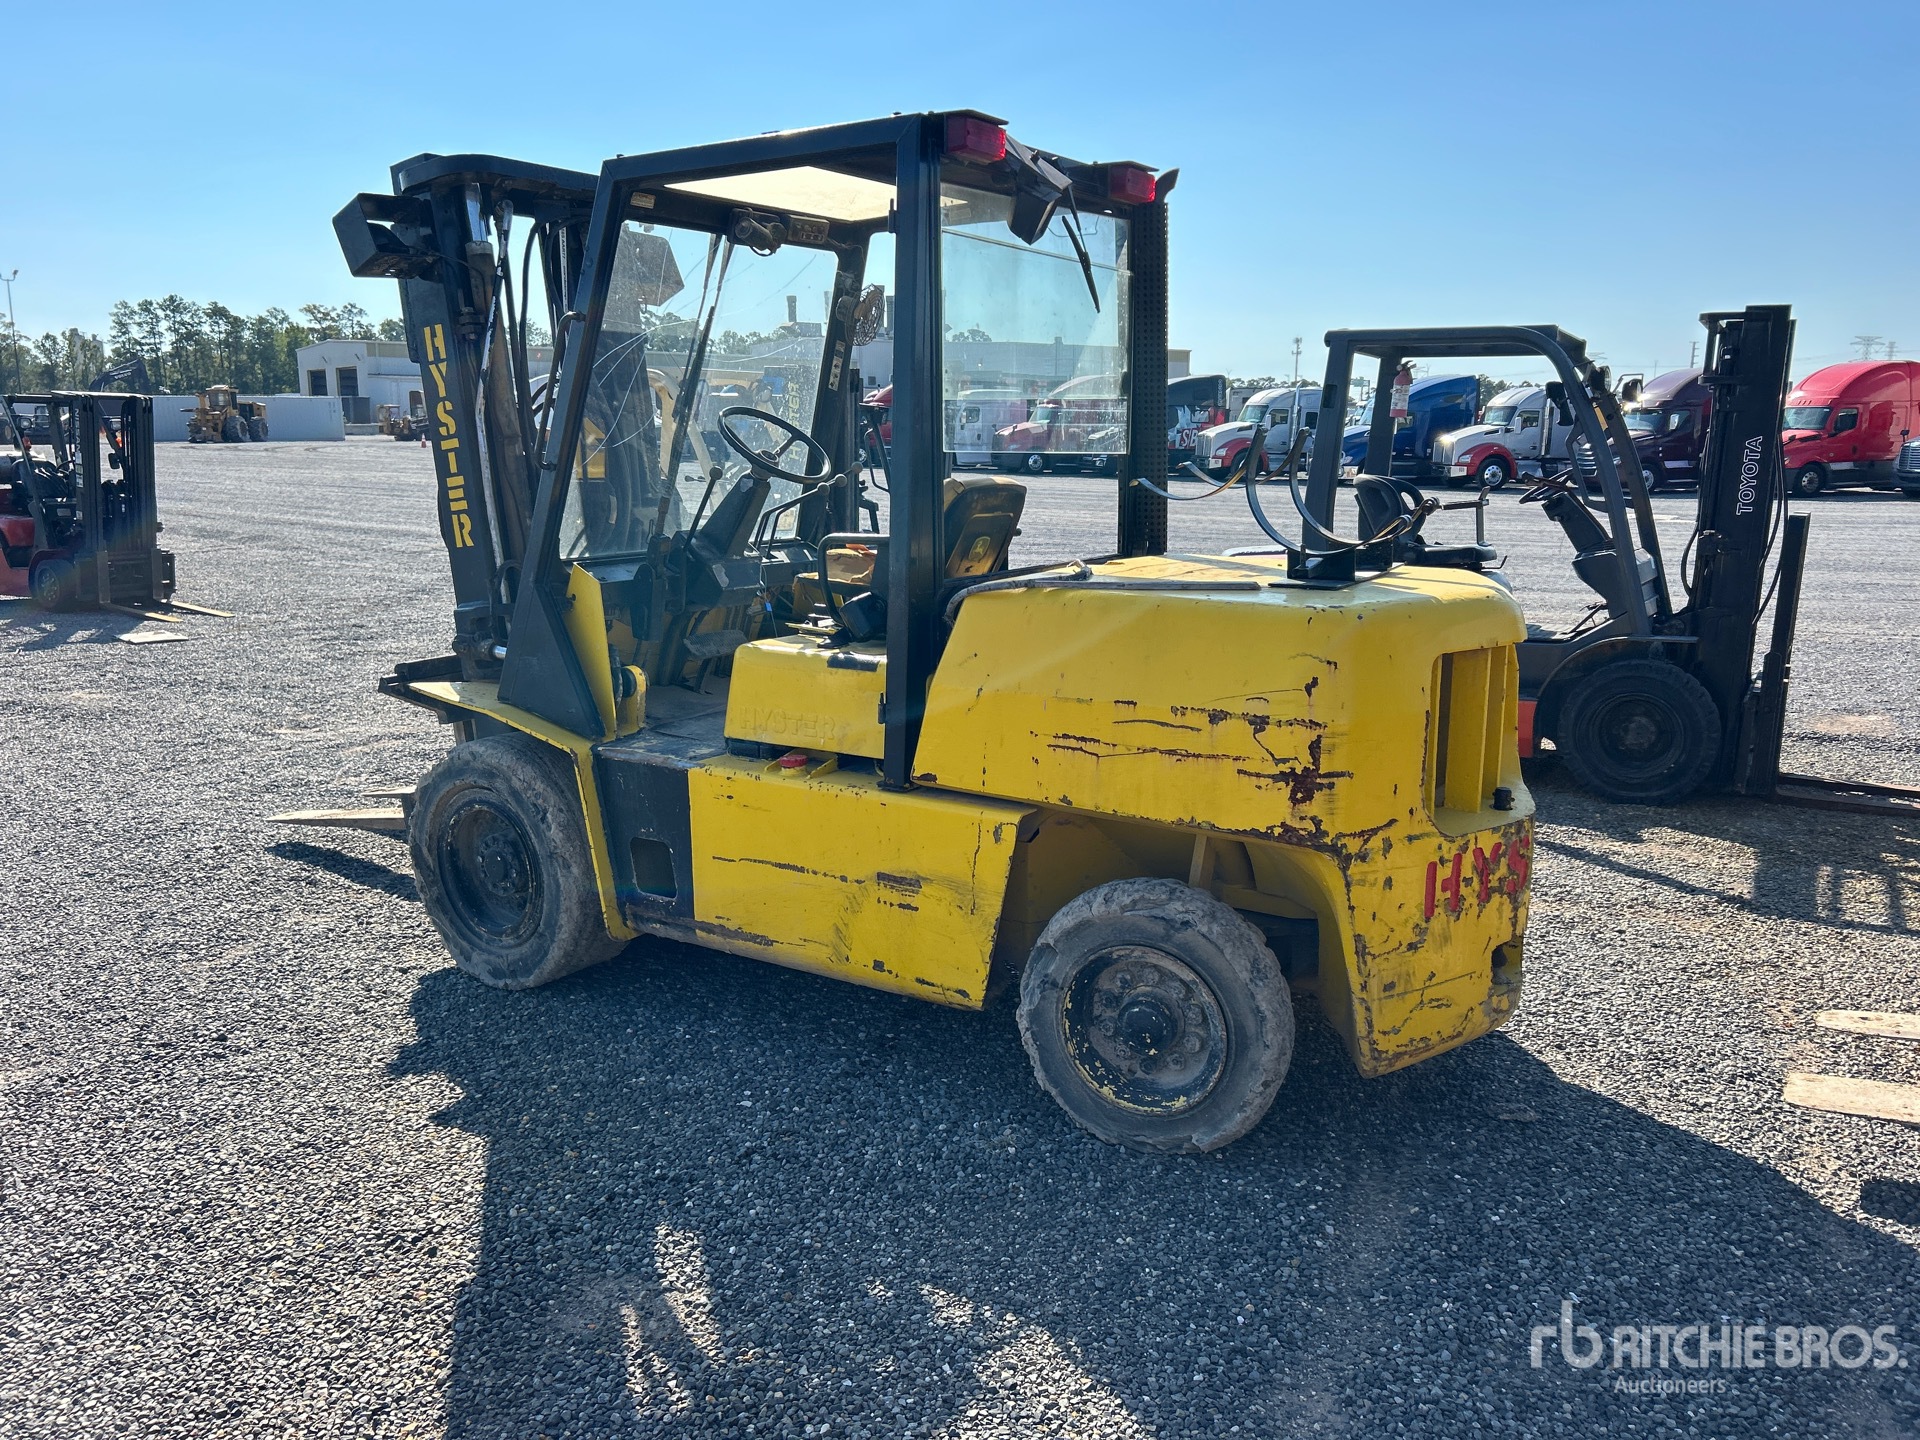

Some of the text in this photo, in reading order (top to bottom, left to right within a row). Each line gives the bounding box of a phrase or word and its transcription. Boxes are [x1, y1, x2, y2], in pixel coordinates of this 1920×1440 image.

[423, 323, 475, 548] HYSTER
[1736, 435, 1763, 515] TOYOTA
[739, 706, 836, 740] HYSTER
